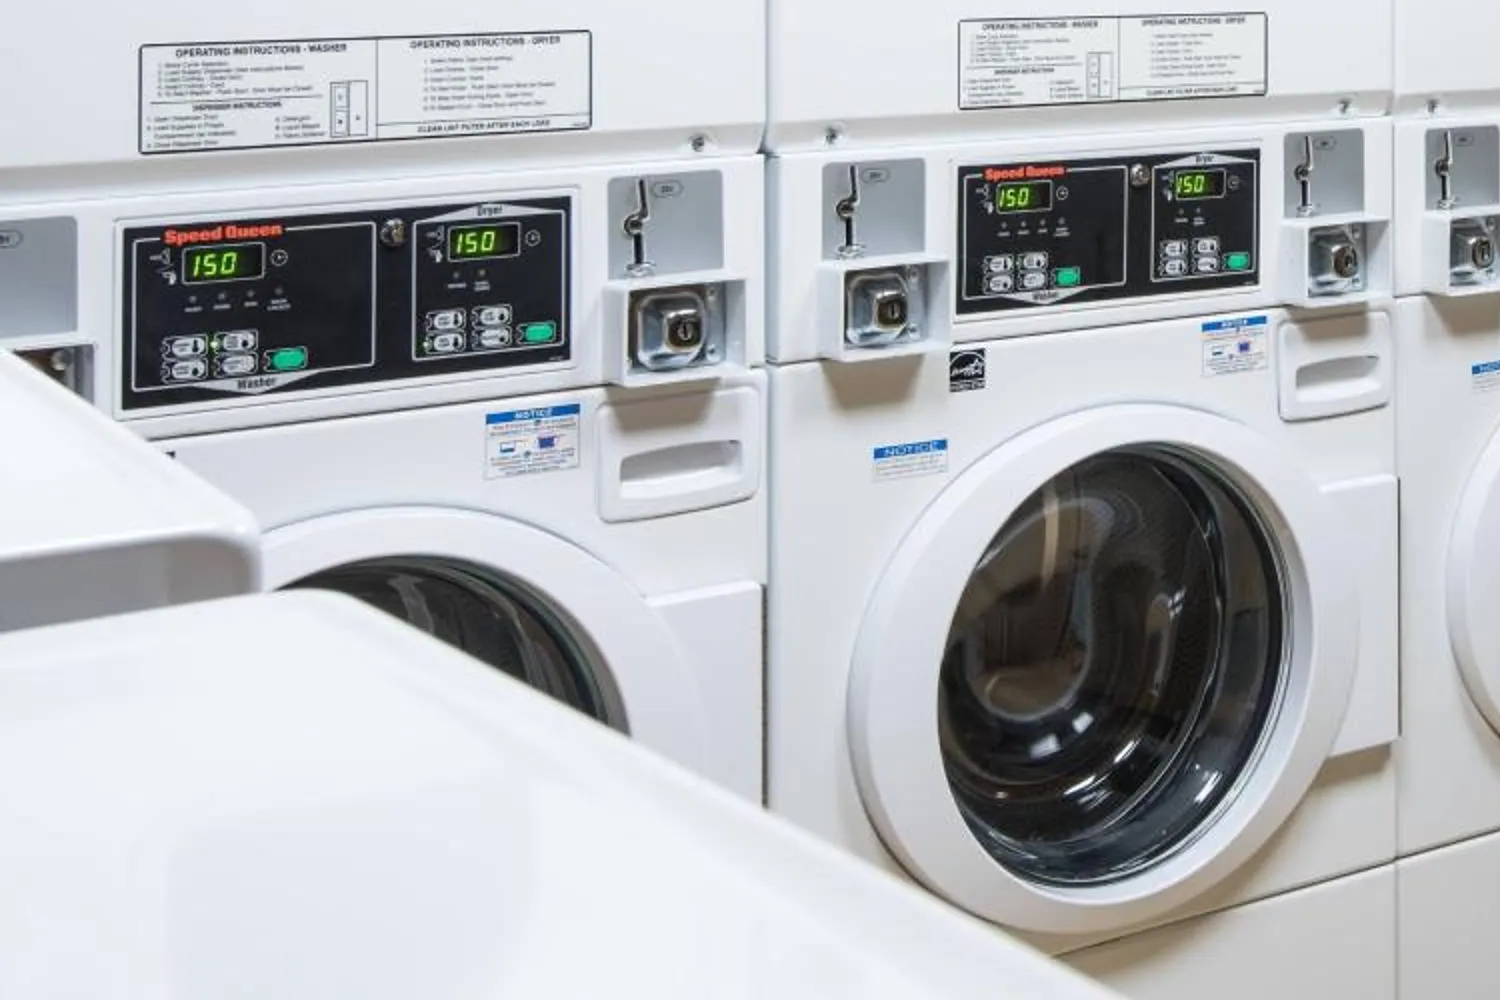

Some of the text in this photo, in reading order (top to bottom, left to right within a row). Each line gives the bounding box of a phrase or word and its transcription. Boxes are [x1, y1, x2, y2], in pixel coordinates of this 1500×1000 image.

[410, 38, 460, 49] OPERATING
[463, 36, 525, 47] INSTRUCTIONS
[532, 35, 561, 45] DRYER
[175, 48, 231, 58] OPERATING
[233, 45, 301, 56] INSTRUCTIONS
[308, 43, 347, 53] WASHER
[461, 122, 485, 131] FILTER
[985, 166, 1065, 182] Speed Queen
[1177, 175, 1205, 193] 150
[999, 187, 1029, 207] 150
[477, 204, 503, 217] Dryer
[164, 223, 283, 245] Speed Queen
[456, 231, 496, 253] 150
[192, 252, 237, 277] 150
[237, 376, 277, 390] Washer
[883, 440, 936, 455] NOTICE
